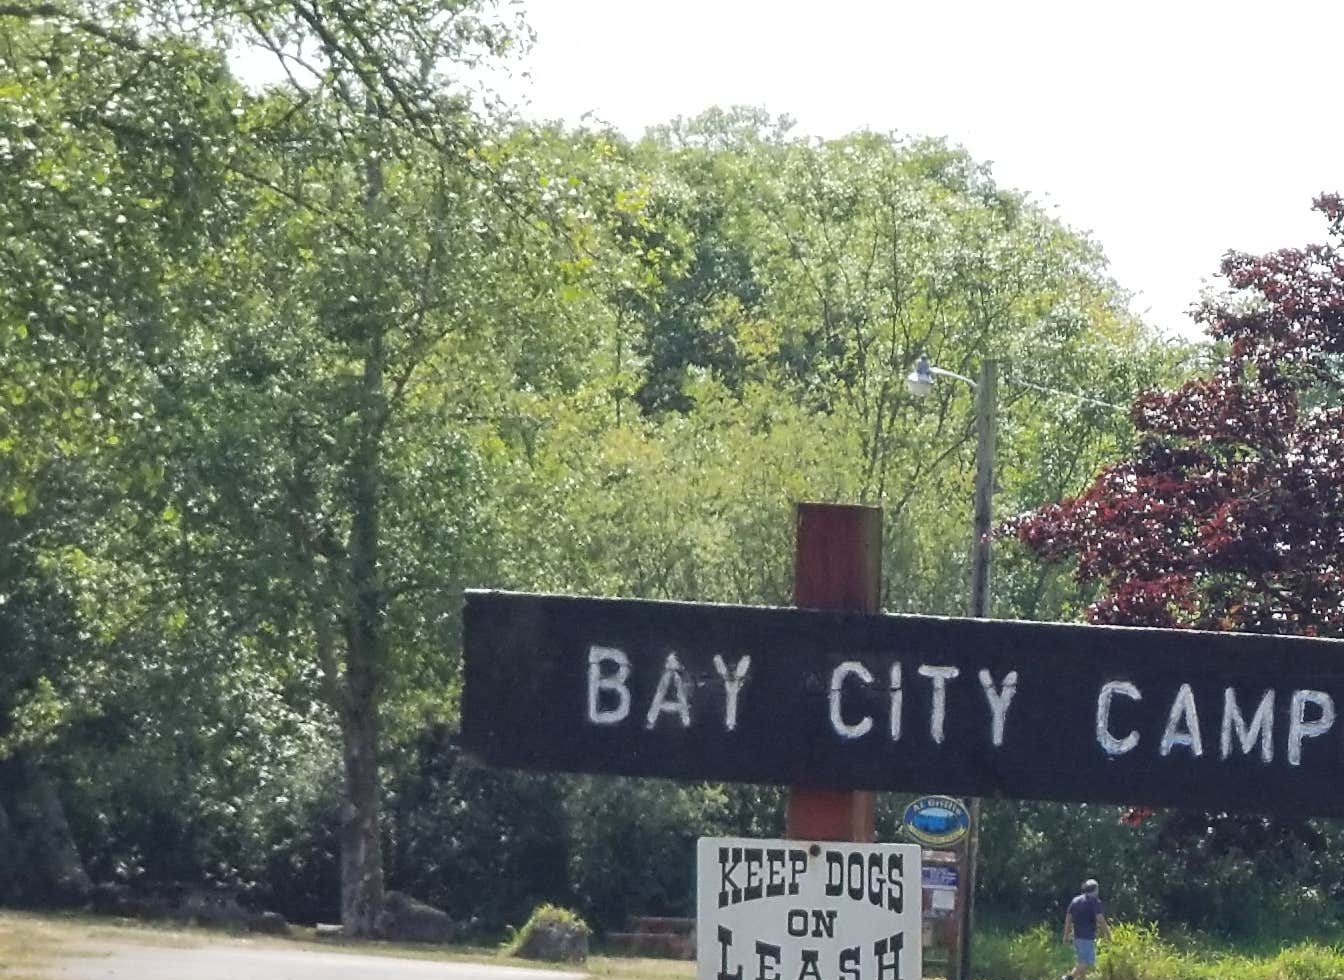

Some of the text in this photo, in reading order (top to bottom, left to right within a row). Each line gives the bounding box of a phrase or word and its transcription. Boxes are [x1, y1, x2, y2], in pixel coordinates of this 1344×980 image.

[588, 645, 751, 731] BAY
[827, 660, 1018, 746] CITY
[718, 847, 904, 914] KEEP DOGS
[787, 909, 838, 938] ON
